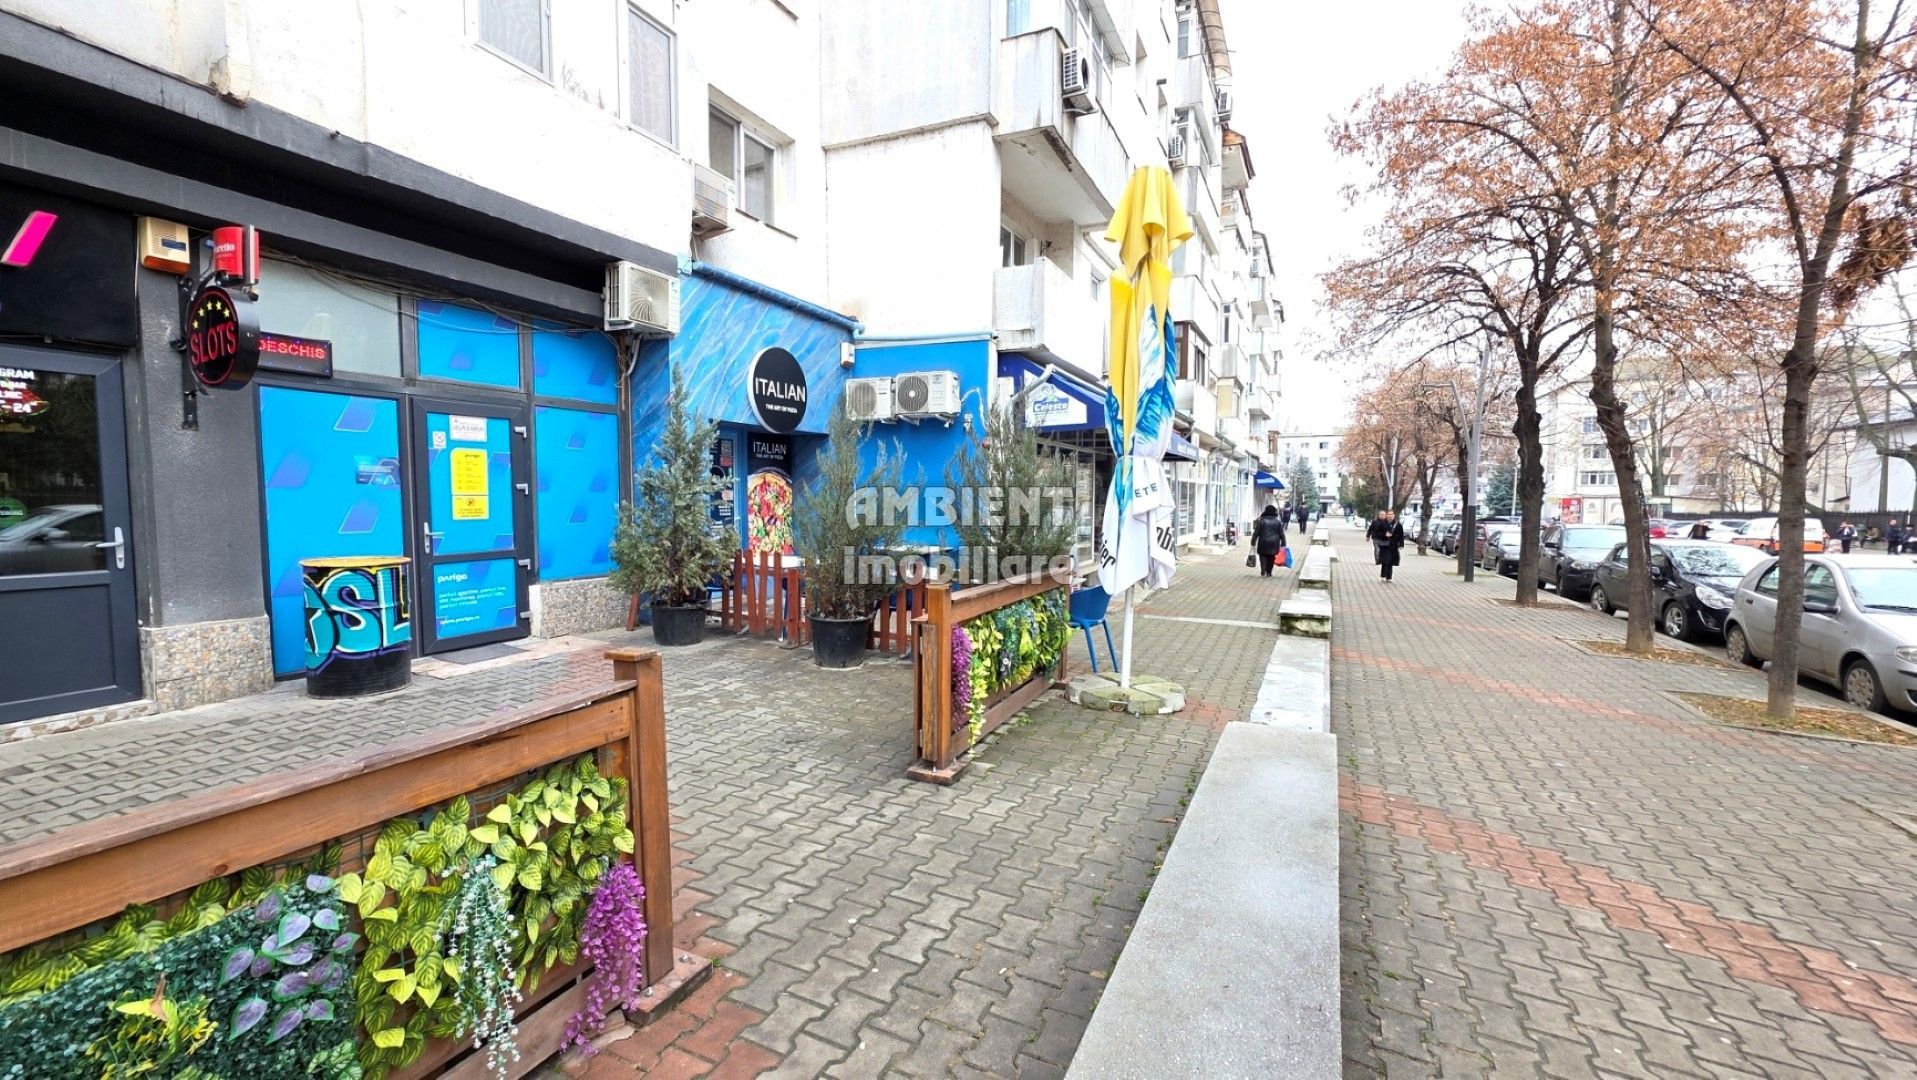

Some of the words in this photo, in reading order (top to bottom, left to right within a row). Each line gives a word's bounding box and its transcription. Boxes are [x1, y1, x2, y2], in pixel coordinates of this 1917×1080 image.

[190, 320, 237, 366] SLOTS
[755, 377, 806, 403] ITALIAN
[753, 441, 787, 455] ITALIAN
